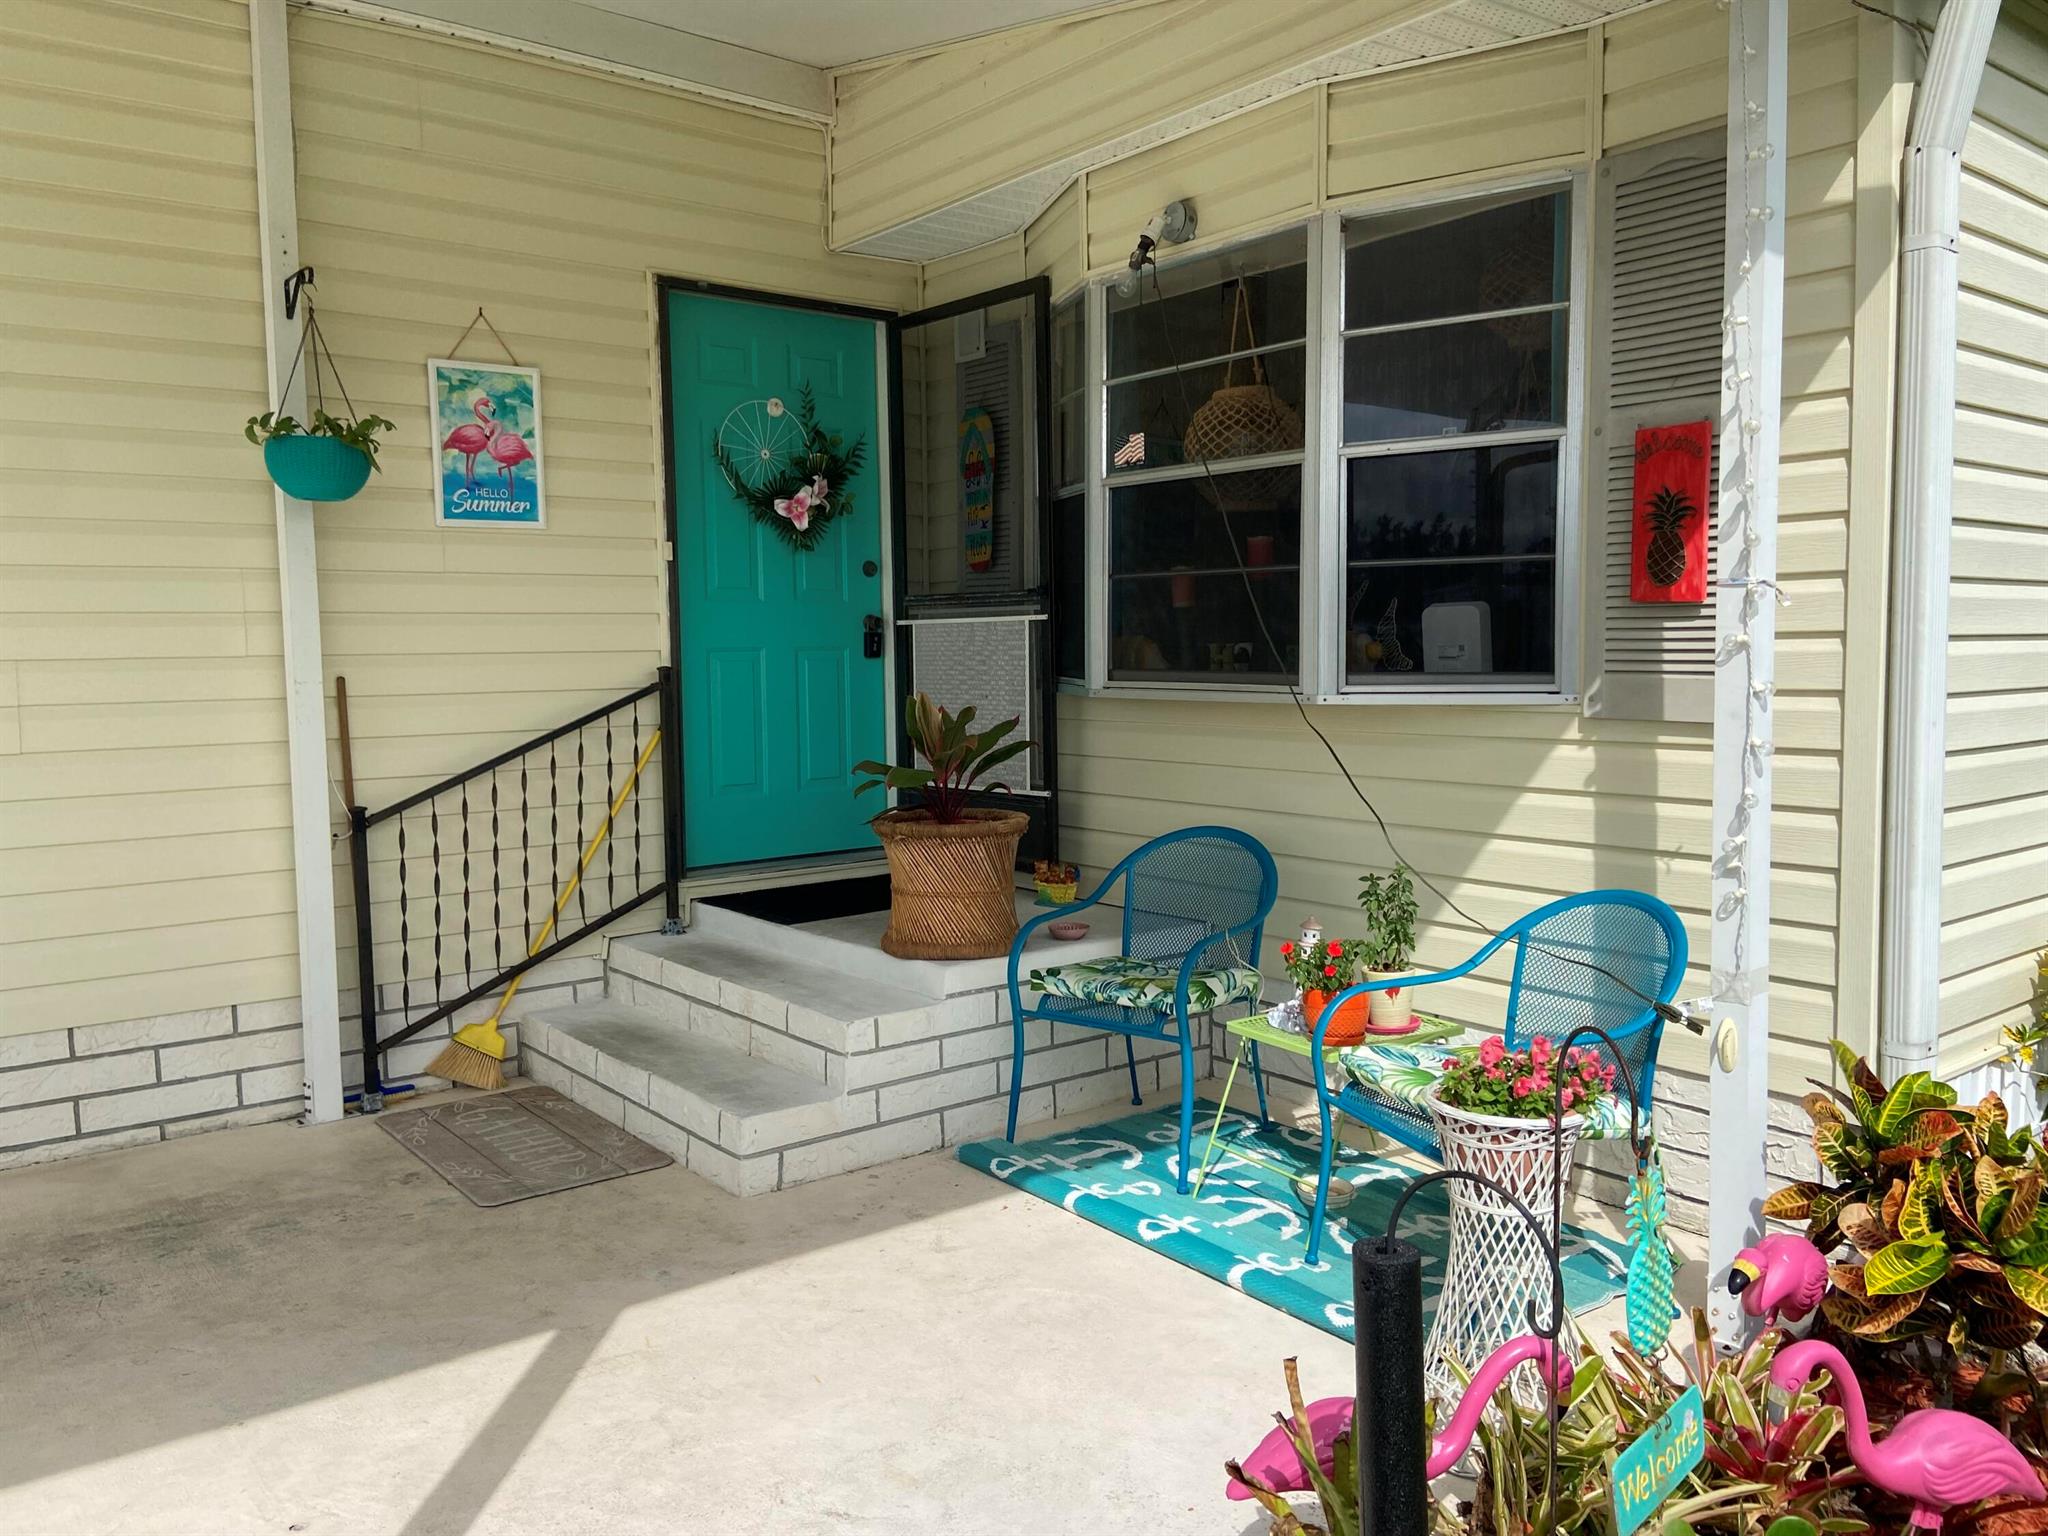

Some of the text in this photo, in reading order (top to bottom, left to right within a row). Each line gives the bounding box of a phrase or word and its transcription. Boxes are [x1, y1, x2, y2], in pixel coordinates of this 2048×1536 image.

[451, 488, 530, 513] Summer
[475, 487, 509, 498] HELLO
[454, 1105, 587, 1172] GATHER
[1619, 1419, 1699, 1512] Welcome
